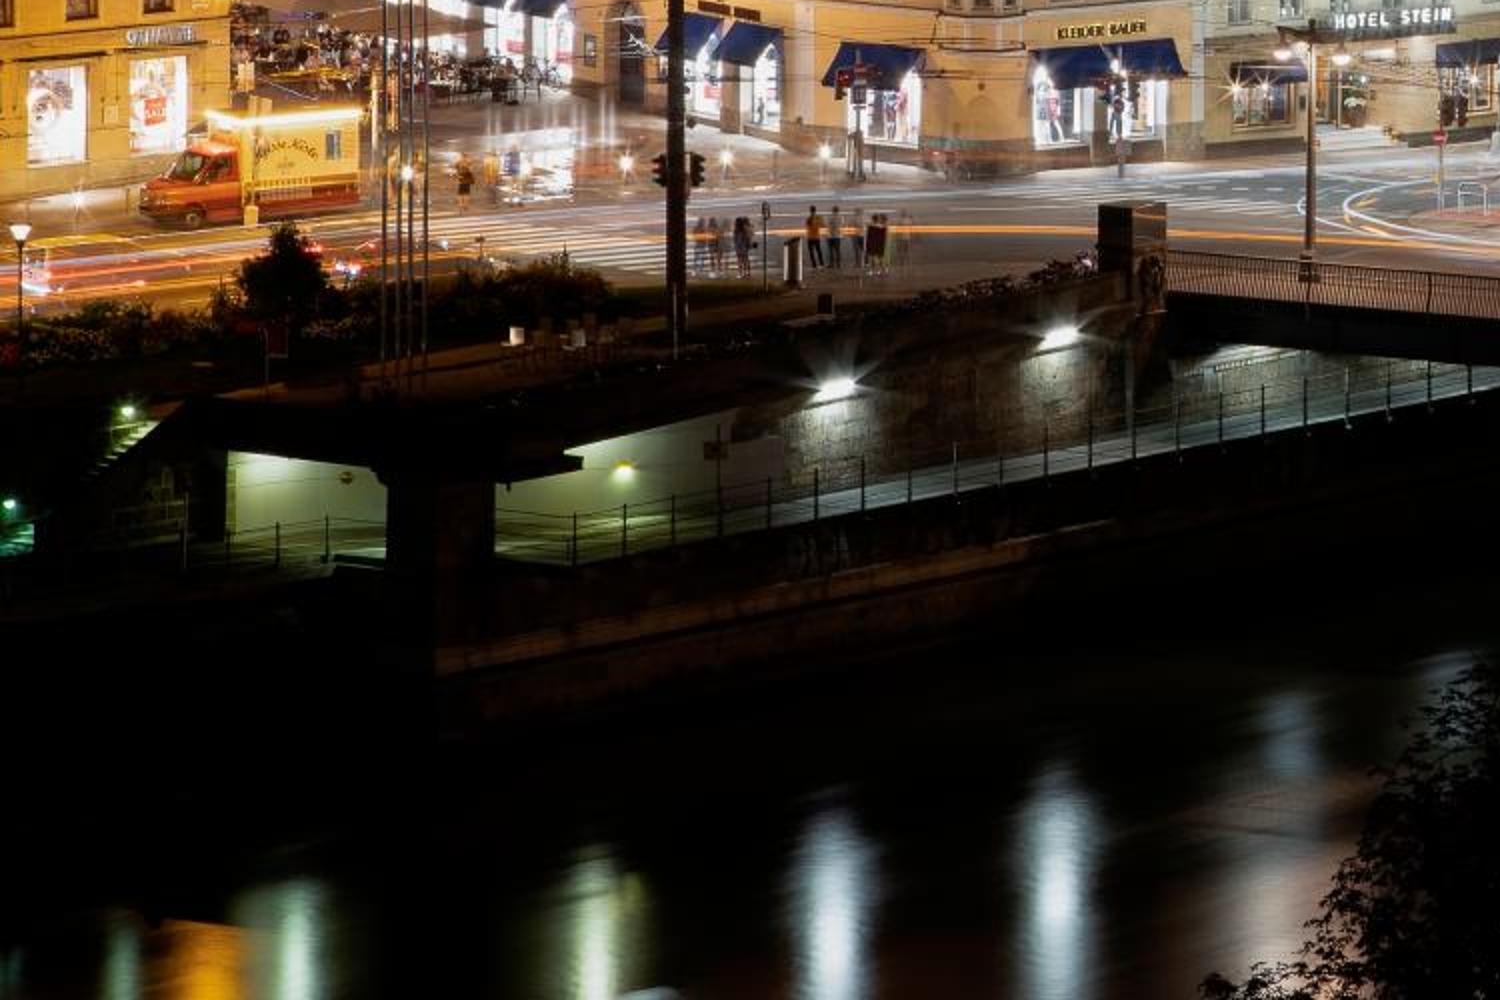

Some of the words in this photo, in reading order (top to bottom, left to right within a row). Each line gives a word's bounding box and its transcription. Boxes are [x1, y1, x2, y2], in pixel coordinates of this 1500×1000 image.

[1335, 11, 1389, 30] HOTEL
[1400, 7, 1452, 25] STEIN
[1057, 25, 1104, 39] KLEIDER
[1110, 22, 1147, 36] BAUER
